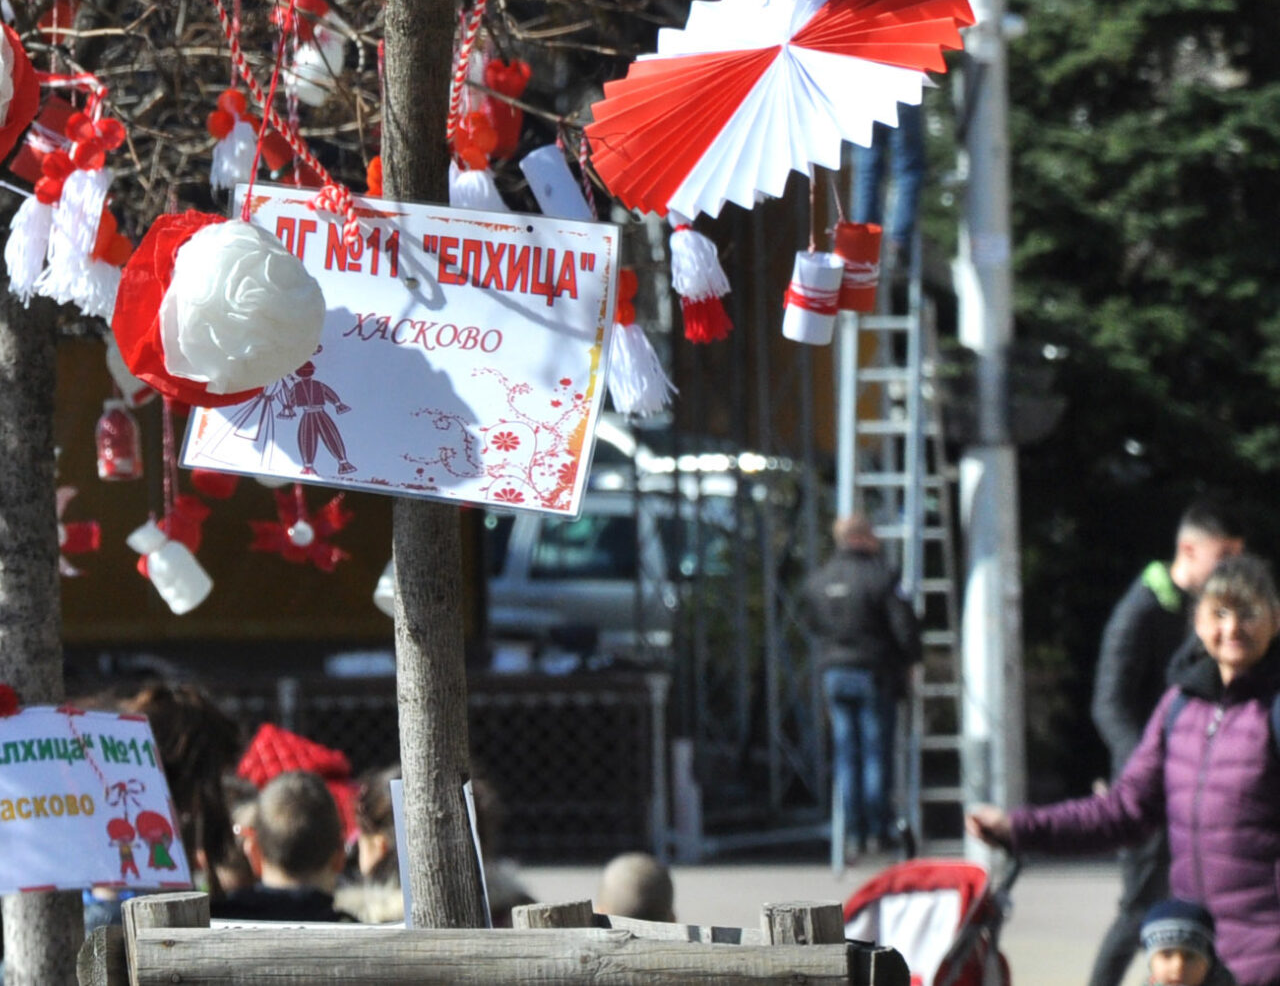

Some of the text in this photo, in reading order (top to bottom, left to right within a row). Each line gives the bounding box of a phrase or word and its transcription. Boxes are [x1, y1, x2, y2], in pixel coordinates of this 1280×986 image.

[324, 222, 400, 278] №11
[423, 234, 596, 307] "ЕЛХИЦА"
[342, 312, 503, 353] ХАСКОВО
[99, 734, 156, 767] №11
